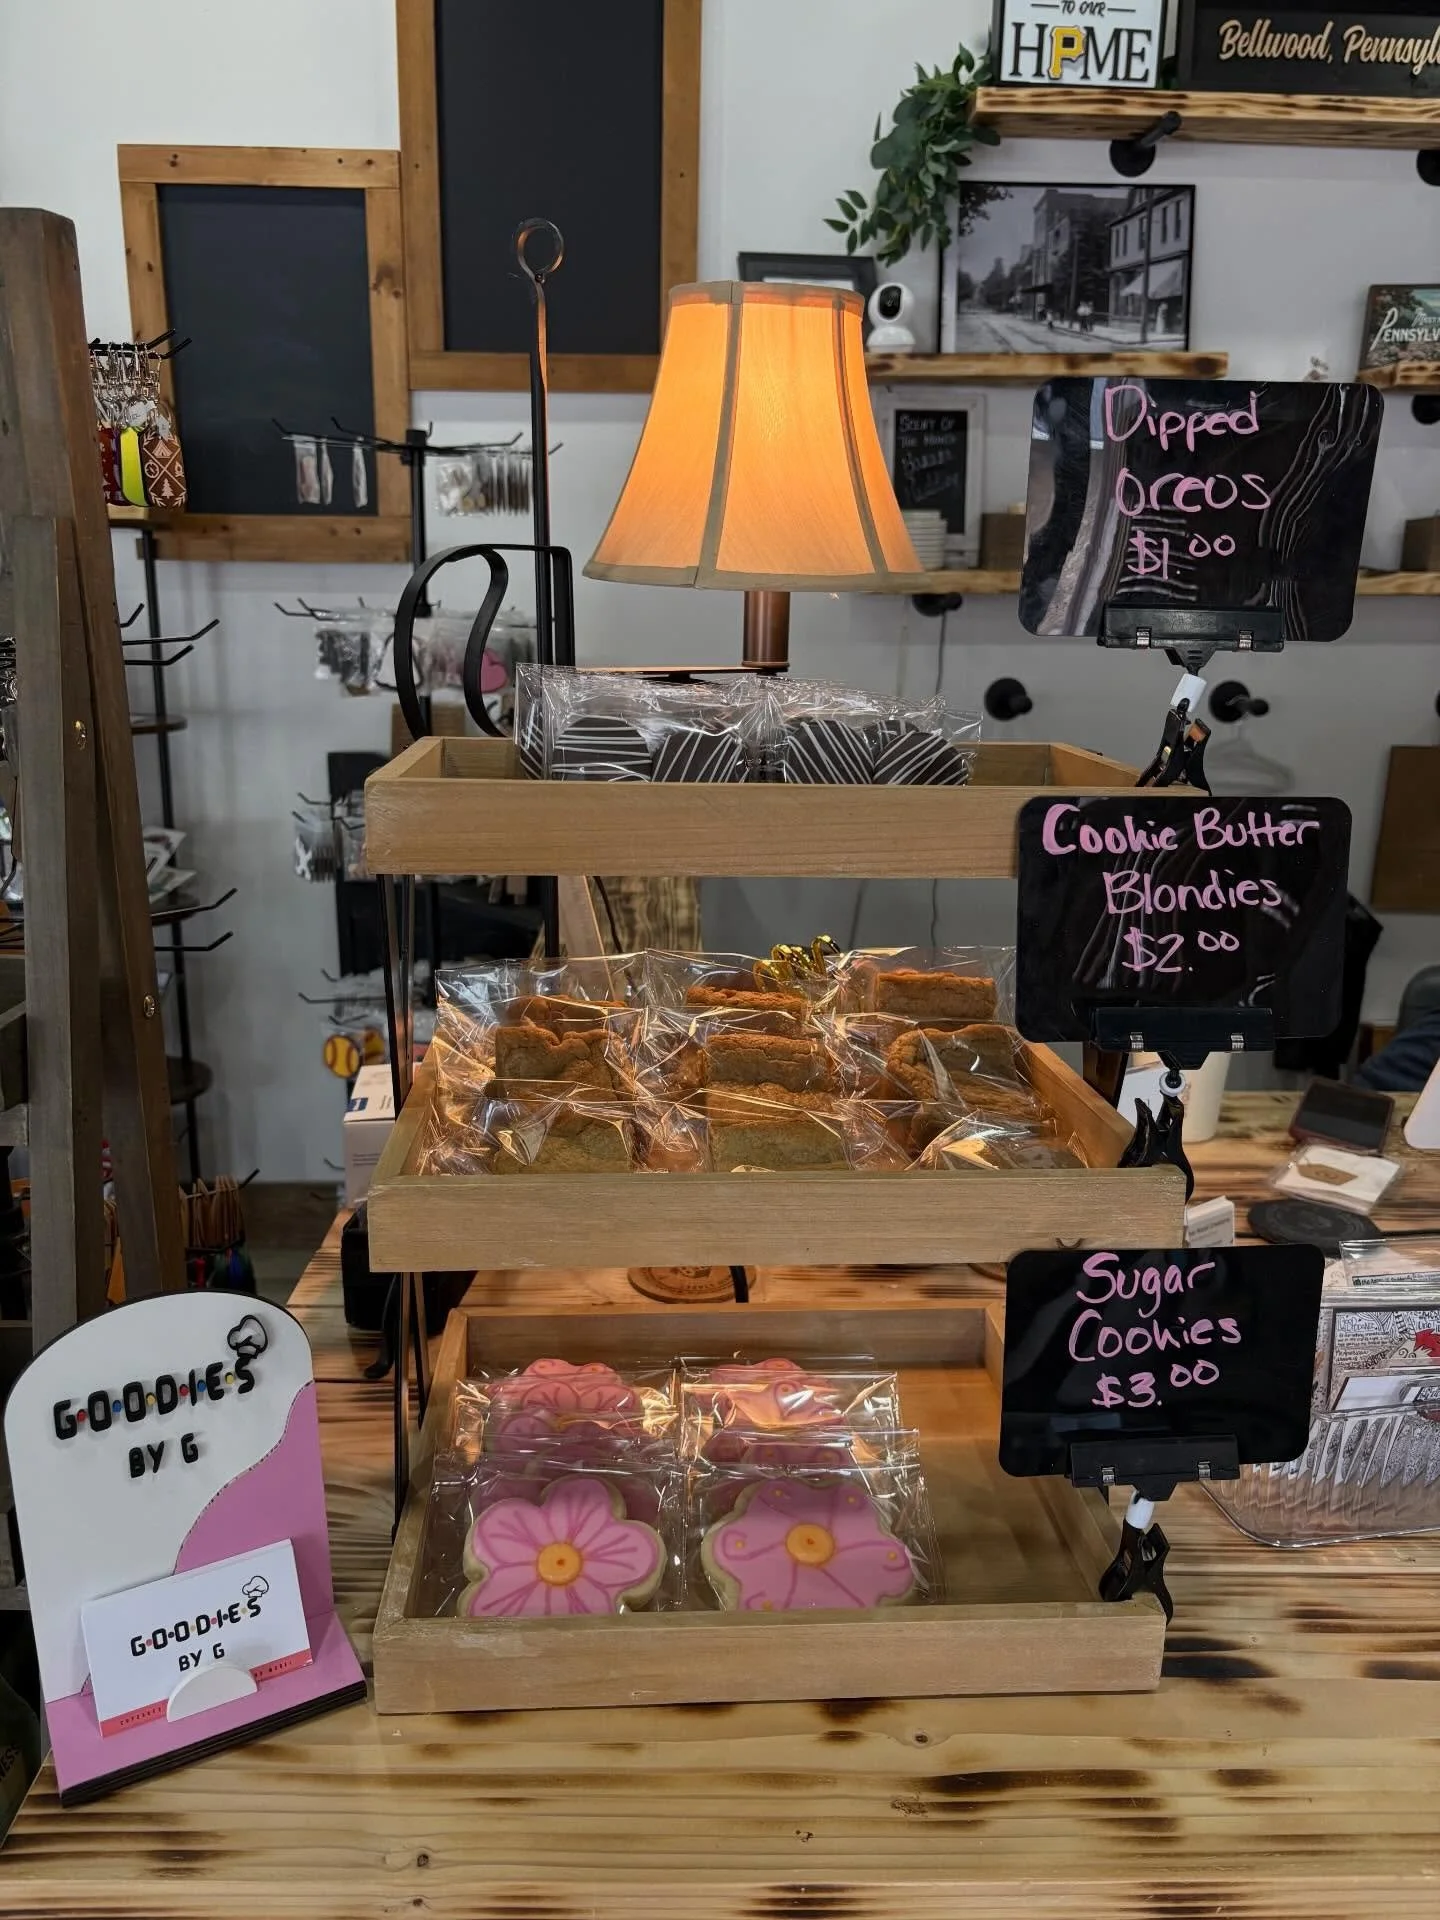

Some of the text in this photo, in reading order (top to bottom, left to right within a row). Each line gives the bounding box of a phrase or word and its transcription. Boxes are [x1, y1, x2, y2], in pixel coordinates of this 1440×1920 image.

[1079, 0, 1107, 17] OUR
[1219, 18, 1334, 64] Bellwood,
[1105, 385, 1260, 452] Dipped
[1115, 467, 1272, 517] Oreos
[1127, 530, 1237, 581] $1.00
[1042, 803, 1320, 855] Cookie Butter
[1102, 868, 1282, 914] Blondies
[1121, 926, 1240, 973] $2.00
[1076, 1251, 1216, 1318] Sugar
[1068, 1308, 1242, 1362] Cookies
[1091, 1359, 1220, 1408] $3.00
[128, 1432, 199, 1479] BY G
[178, 1642, 226, 1672] BY G
